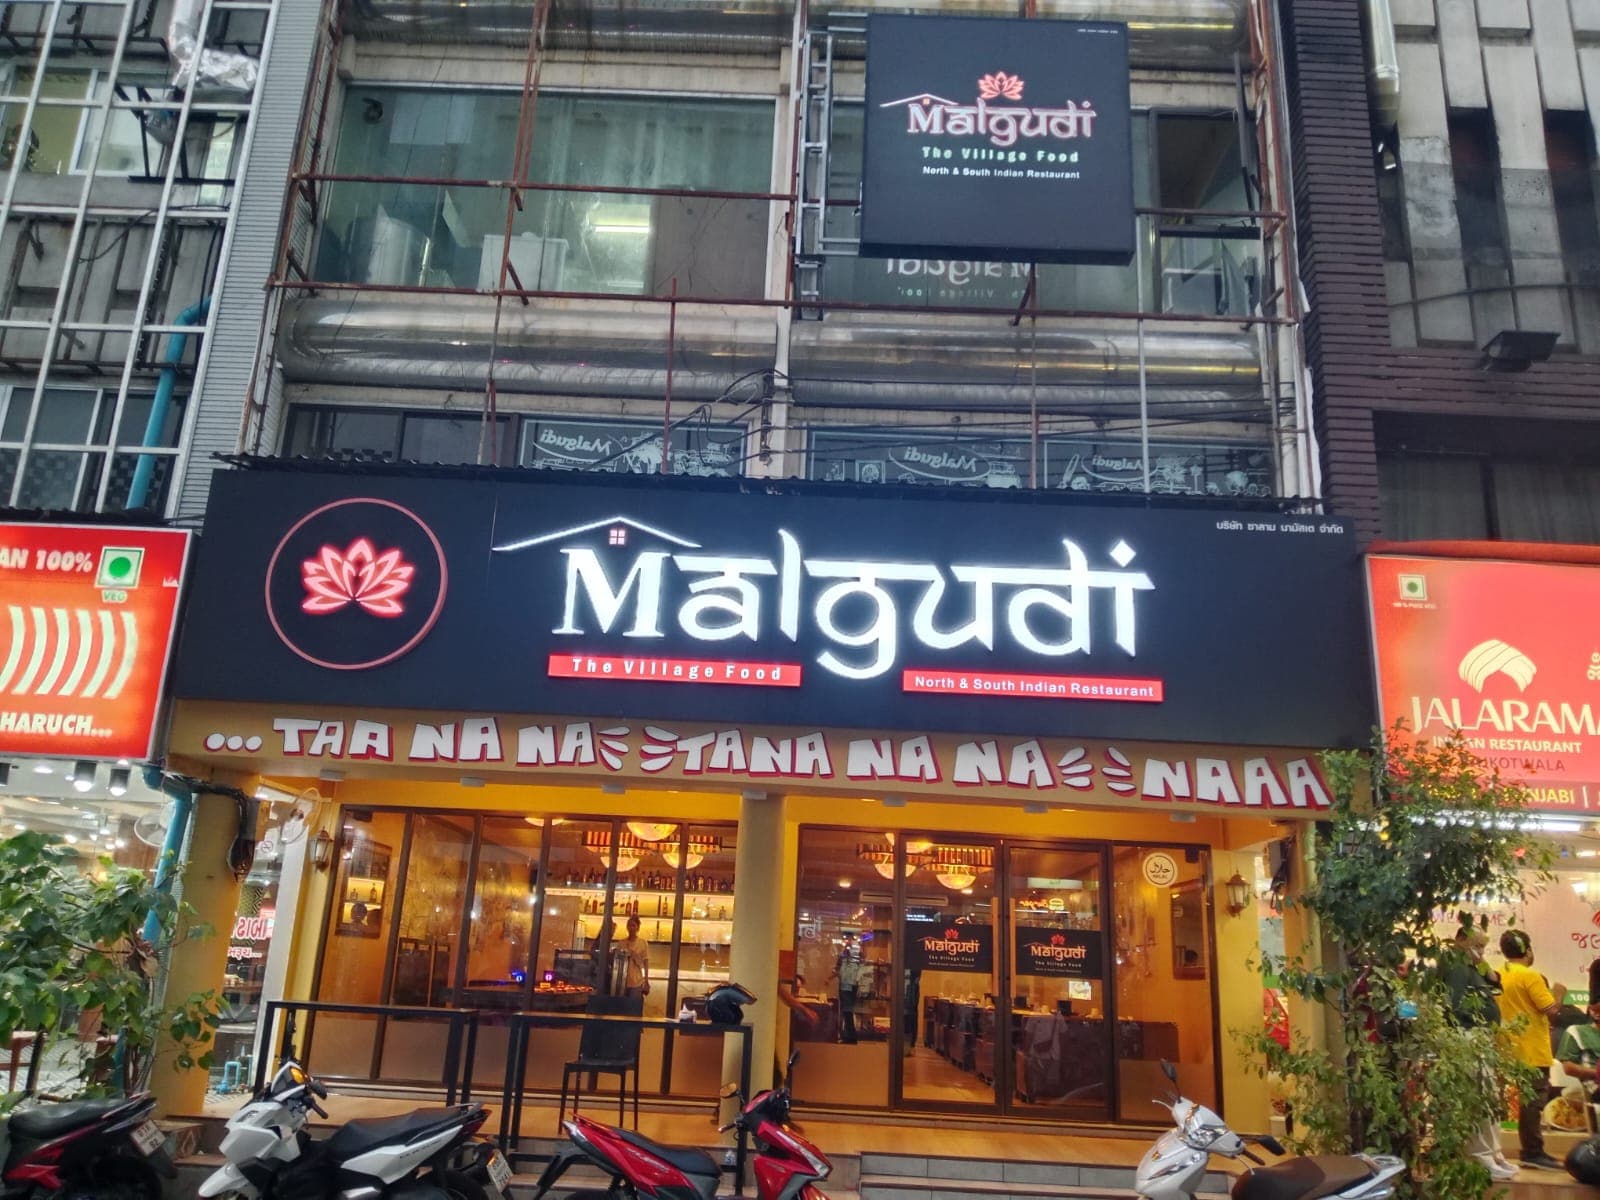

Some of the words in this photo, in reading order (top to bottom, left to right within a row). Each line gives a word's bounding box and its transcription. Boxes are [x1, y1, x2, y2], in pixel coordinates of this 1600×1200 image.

[907, 97, 1097, 146] Malgudi
[922, 146, 952, 159] The
[961, 148, 1027, 163] Village
[1036, 150, 1079, 163] Food
[922, 166, 950, 176] North
[952, 168, 960, 176] &
[962, 167, 991, 177] South
[993, 168, 1024, 178] Indian
[1026, 169, 1081, 180] Restaurant
[36, 549, 93, 573] 100%
[104, 591, 125, 601] VEG
[552, 528, 1156, 680] Malgudi
[572, 658, 612, 674] The
[623, 660, 714, 680] Village
[725, 665, 782, 681] Food
[914, 675, 955, 689] North
[959, 677, 969, 689] &
[973, 678, 1016, 692] South
[1020, 681, 1066, 694] Indian
[1071, 683, 1154, 697] Restaurant
[1411, 696, 1600, 737] JALARAM
[1488, 738, 1582, 754] RESTAURANT
[846, 734, 944, 784] NA
[953, 738, 1059, 790] NA
[1140, 756, 1334, 811] NAAA
[924, 939, 981, 955] Malgudi
[1031, 944, 1087, 961] Malgudi
